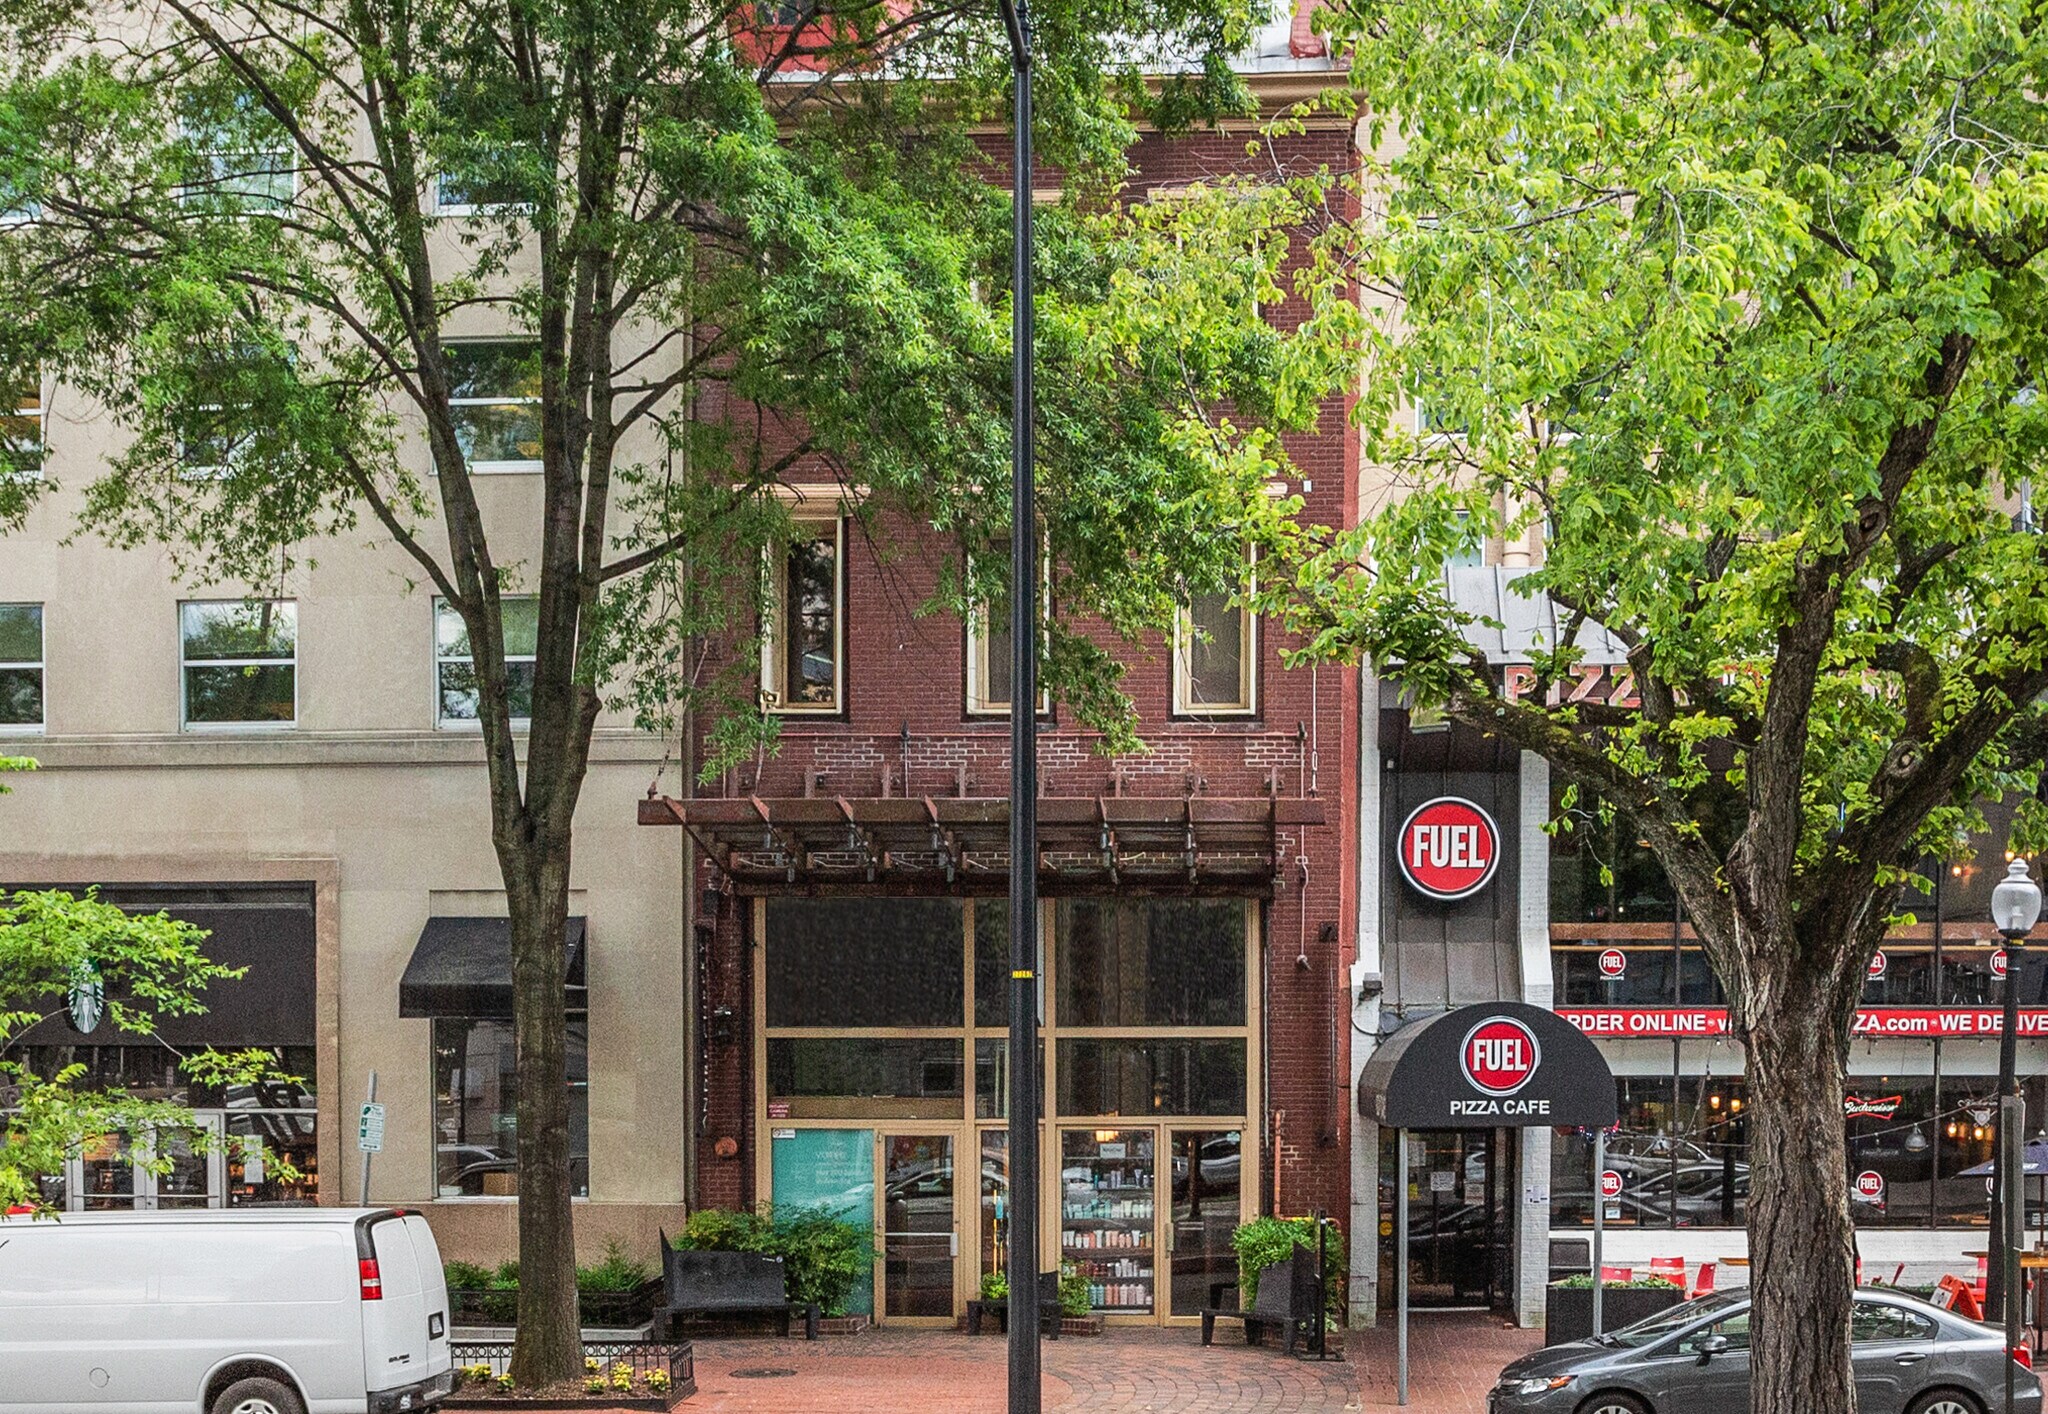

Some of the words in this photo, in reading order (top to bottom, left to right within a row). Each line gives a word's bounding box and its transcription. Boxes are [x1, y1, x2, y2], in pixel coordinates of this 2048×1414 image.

[1504, 665, 1690, 709] PIZZ
[1413, 825, 1485, 868] FUEL
[1603, 956, 1622, 968] FUEL
[1870, 956, 1883, 968] EL
[1629, 1014, 1706, 1031] ONLINE
[1940, 1014, 1972, 1031] WE
[1979, 1014, 2048, 1031] DEIVE
[1473, 1039, 1527, 1071] FUEL
[1450, 1101, 1500, 1115] PIZZA
[1503, 1100, 1550, 1114] CAFE
[1860, 1178, 1879, 1189] FUEL
